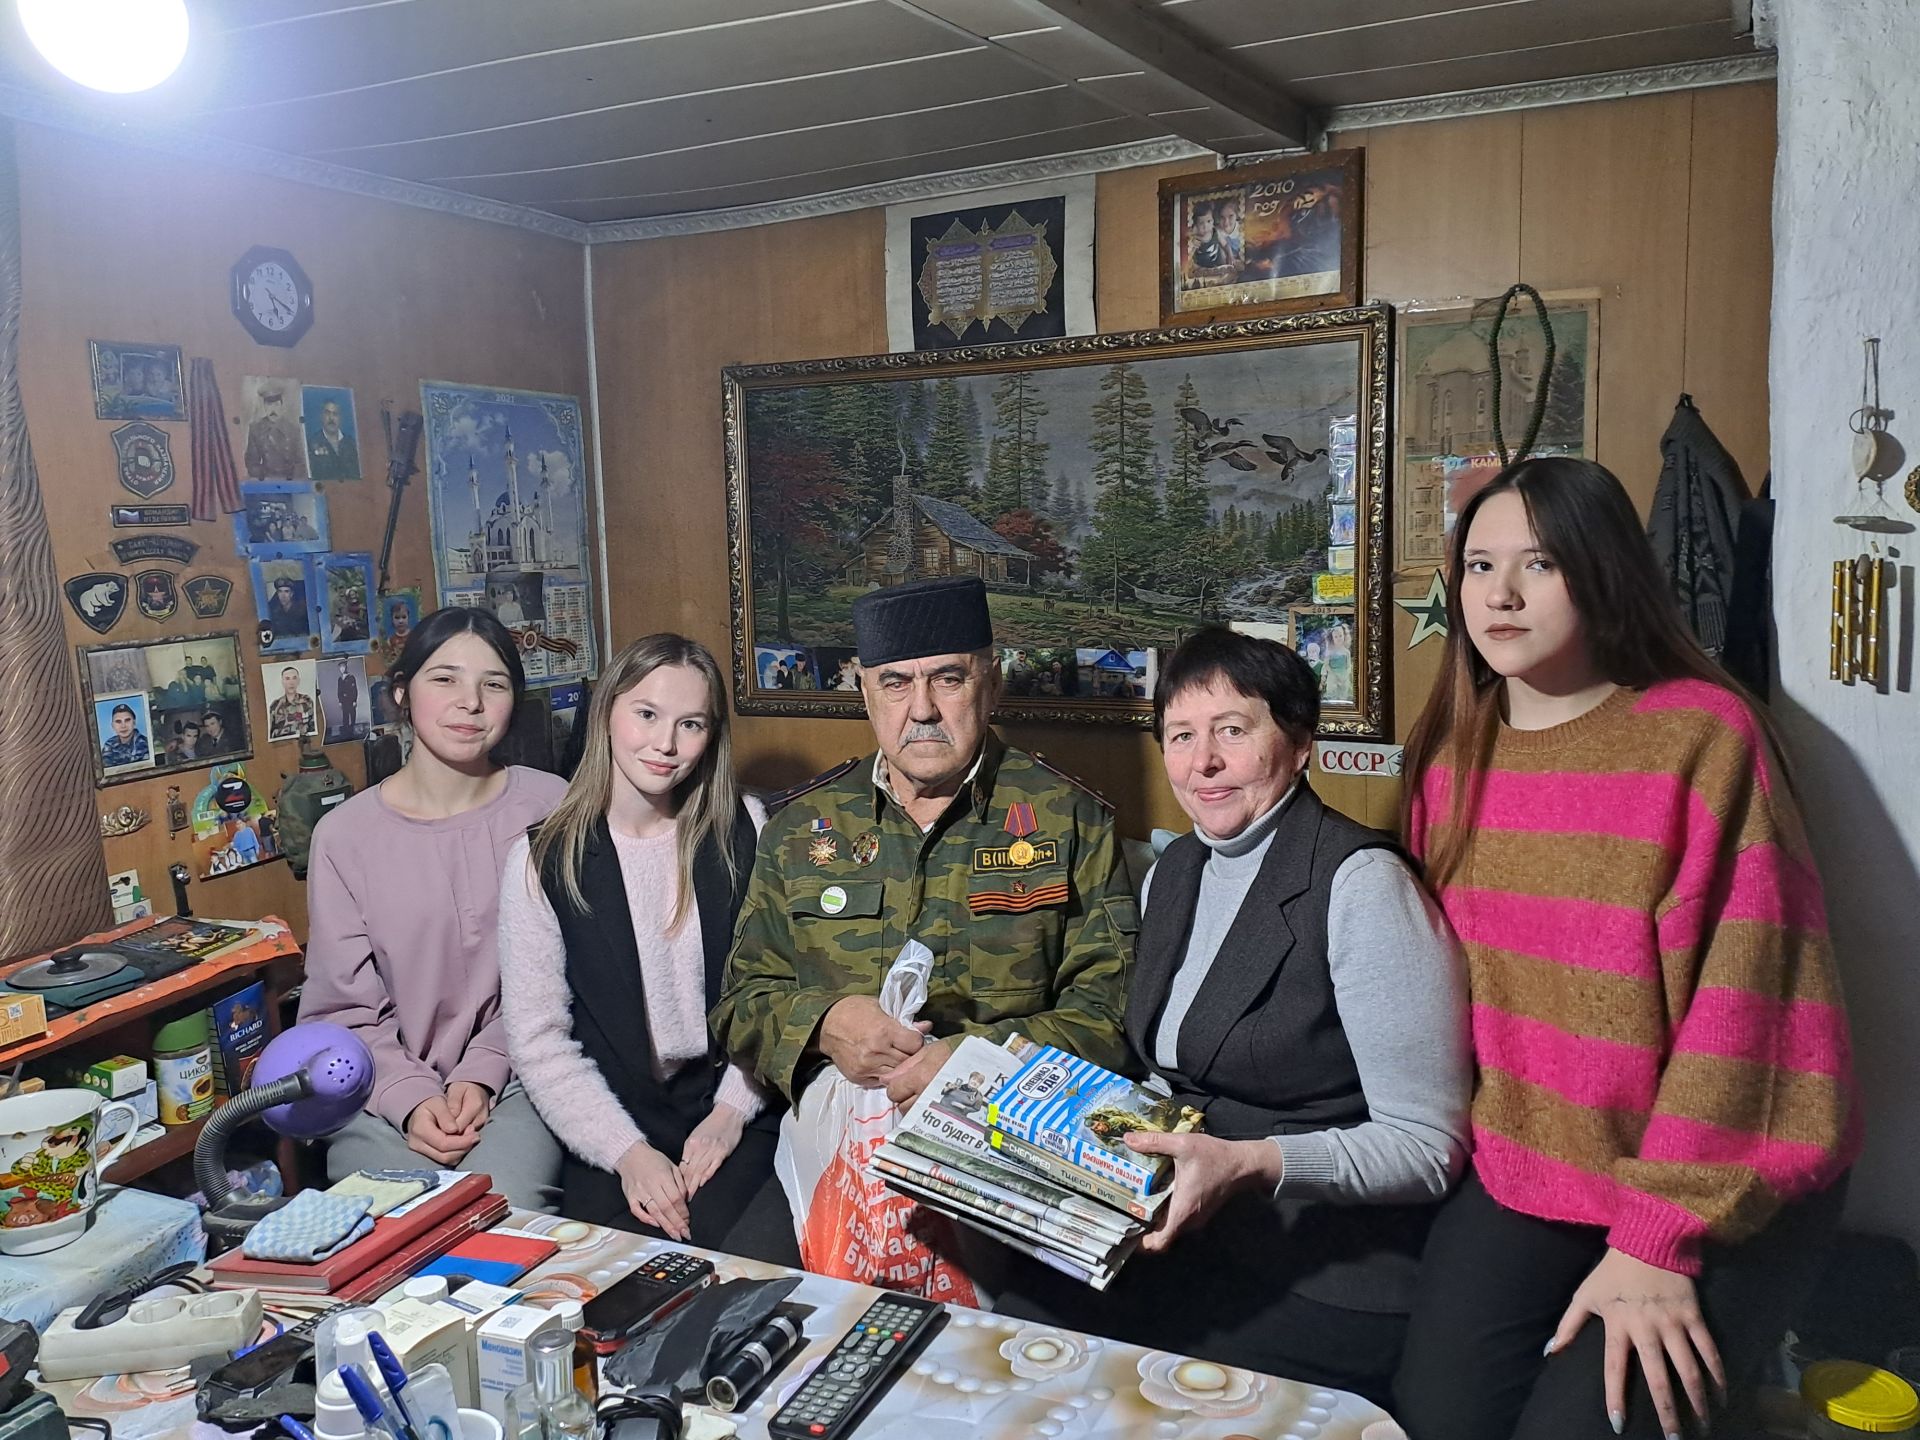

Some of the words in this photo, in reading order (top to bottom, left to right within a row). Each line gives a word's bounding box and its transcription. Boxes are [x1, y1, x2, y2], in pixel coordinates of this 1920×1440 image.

[1249, 179, 1295, 199] 2010
[495, 393, 515, 402] 2021
[1322, 750, 1384, 771] СССР
[230, 1020, 263, 1041] RICHARD
[1021, 1066, 1051, 1091] СПЕЦНАЗ
[1037, 1073, 1061, 1093] ВДВ
[921, 1109, 941, 1128] Что
[941, 1118, 976, 1146] будет
[976, 1138, 984, 1149] в
[1047, 1132, 1064, 1143] ВДВ
[1082, 1151, 1115, 1172] СНАЙПЕРОВ
[1115, 1166, 1144, 1186] БРАТСТВО
[480, 1338, 523, 1357] Меновазин
